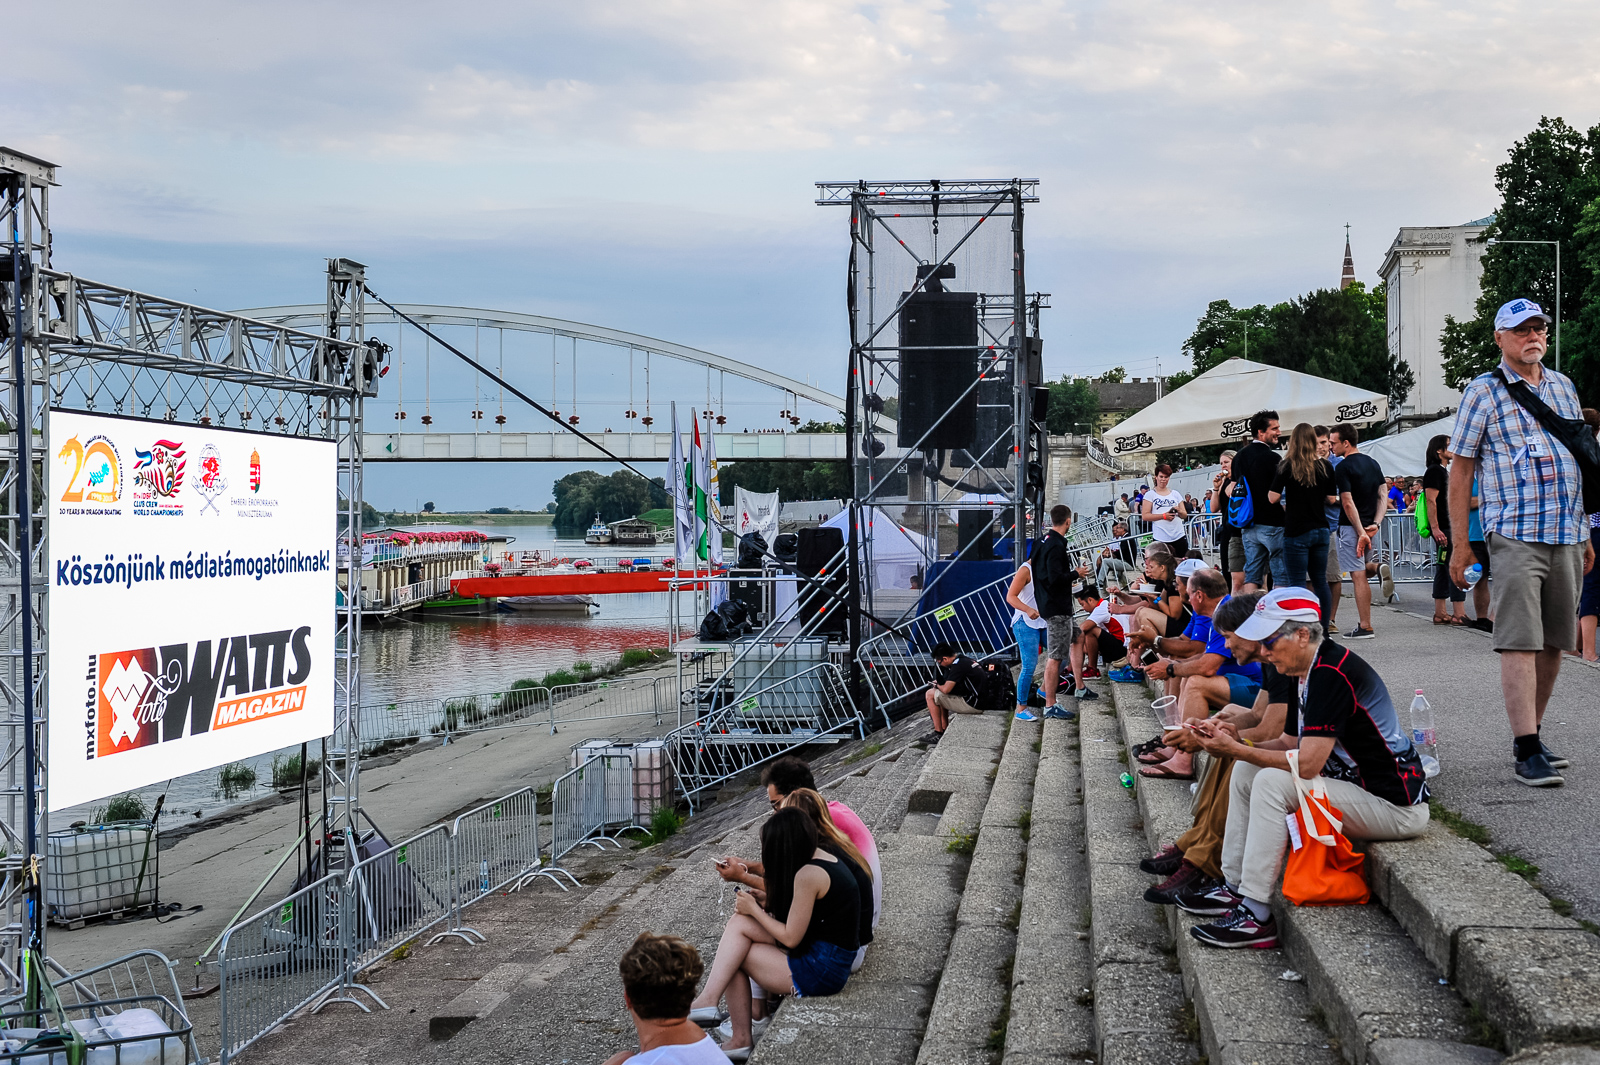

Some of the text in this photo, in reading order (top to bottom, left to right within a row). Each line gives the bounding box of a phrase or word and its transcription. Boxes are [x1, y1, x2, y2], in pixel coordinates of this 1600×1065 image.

[66, 508, 80, 516] YEARS
[86, 508, 104, 516] DRAGON
[104, 508, 122, 516] BOATING
[150, 509, 184, 517] CHAMPIONSHIPS
[57, 549, 330, 589] Köszönjünk médiatámogatóinknak!
[159, 625, 311, 742] WATTS
[85, 654, 97, 760] mxfoto.hu
[216, 689, 304, 726] MAGAZIN
